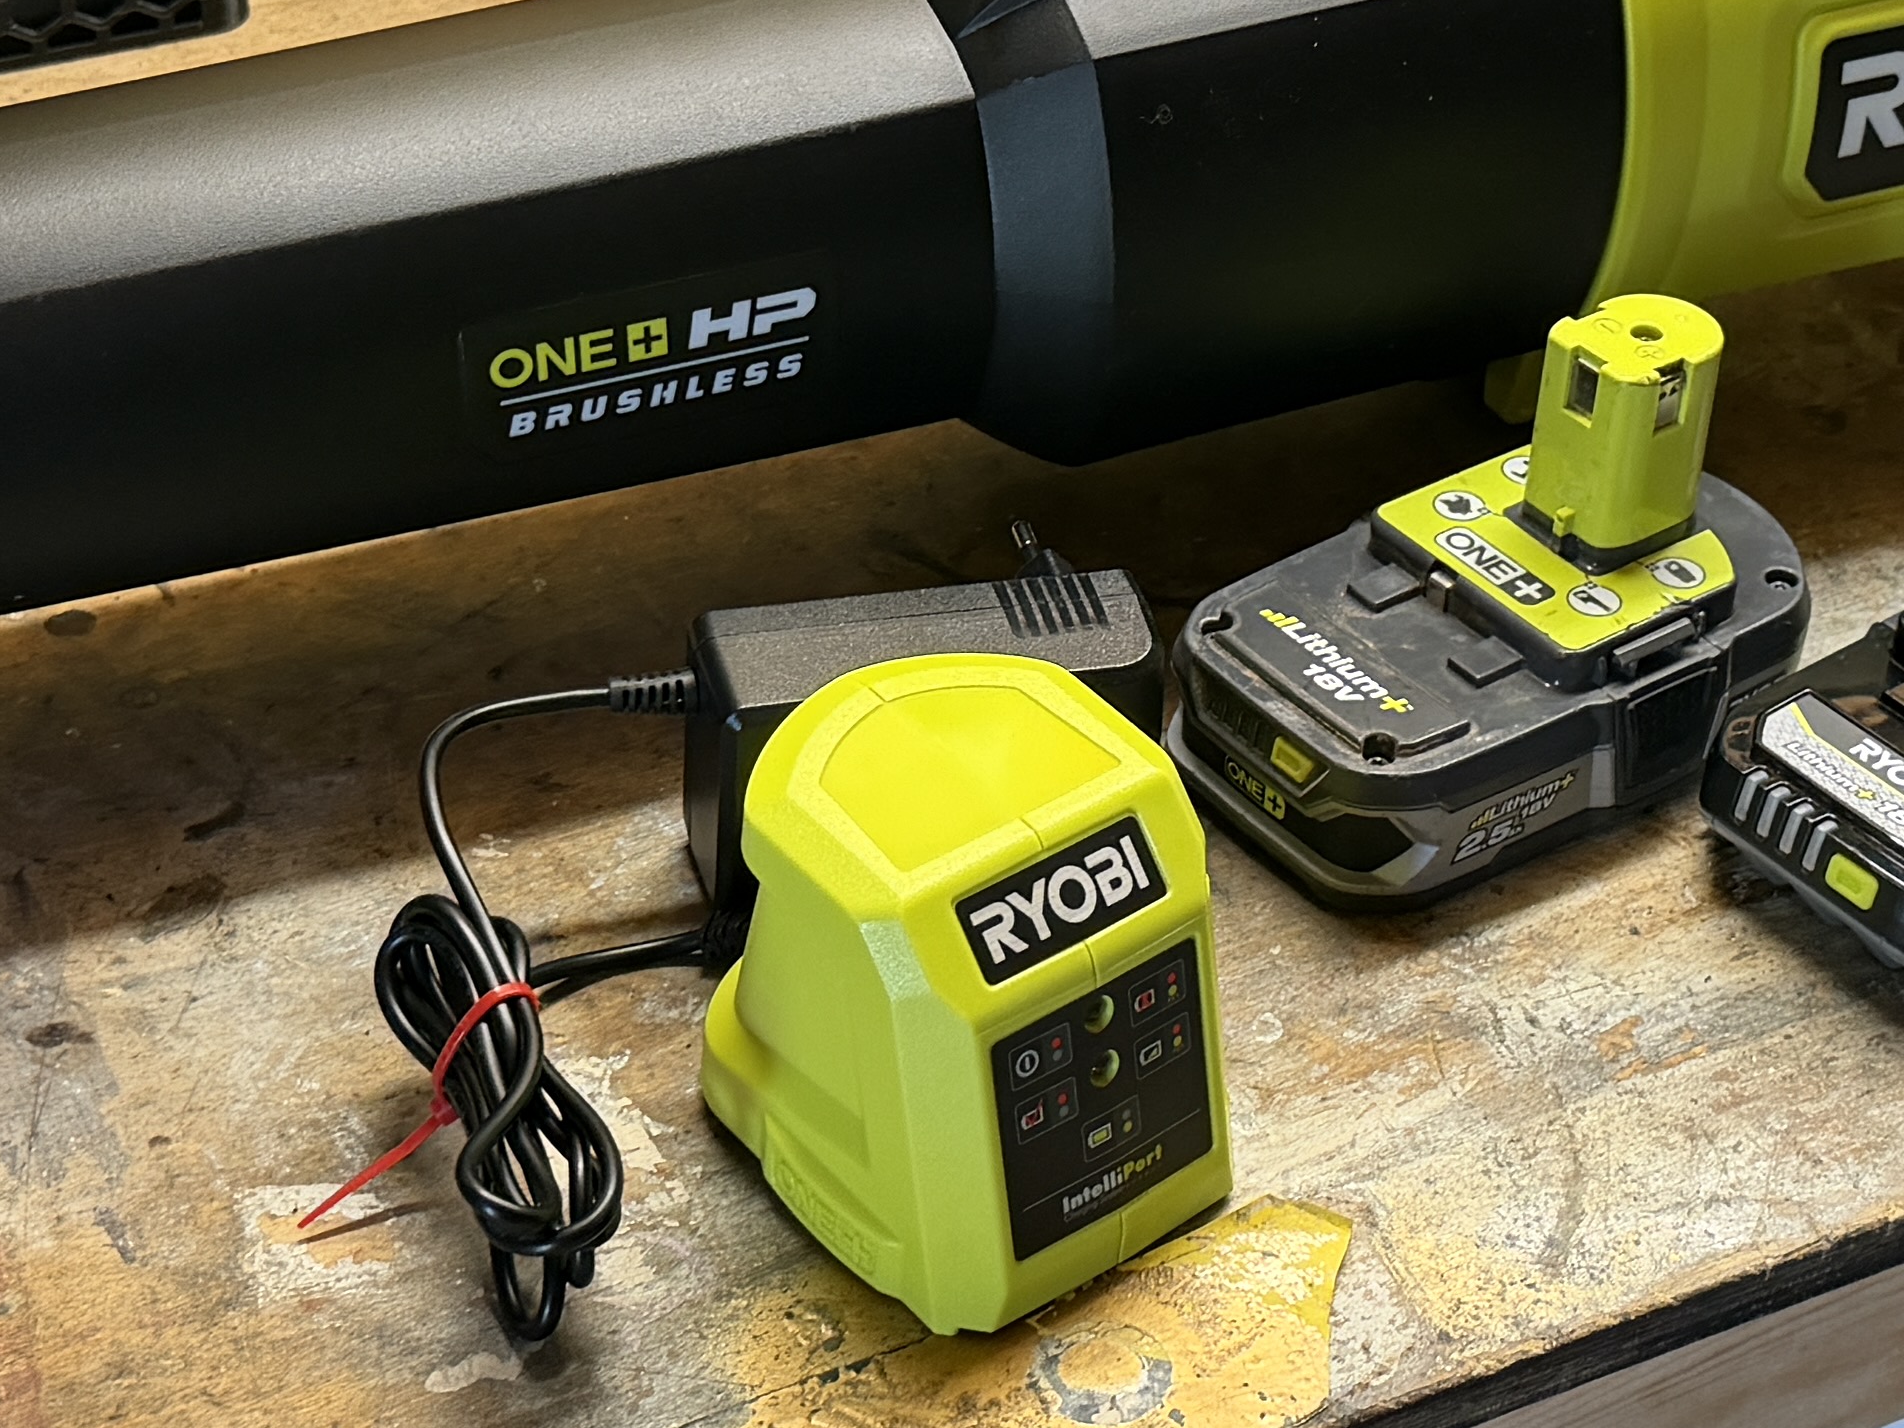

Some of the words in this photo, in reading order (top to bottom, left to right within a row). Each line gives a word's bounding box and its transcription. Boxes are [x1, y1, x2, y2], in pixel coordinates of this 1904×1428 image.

[688, 286, 818, 351] HP
[507, 352, 804, 439] BRUSHLESS
[1302, 663, 1365, 702] 18V
[1520, 792, 1557, 821] 18V
[969, 834, 1151, 965] RYOBI
[1062, 1143, 1162, 1215] IntelliPort
